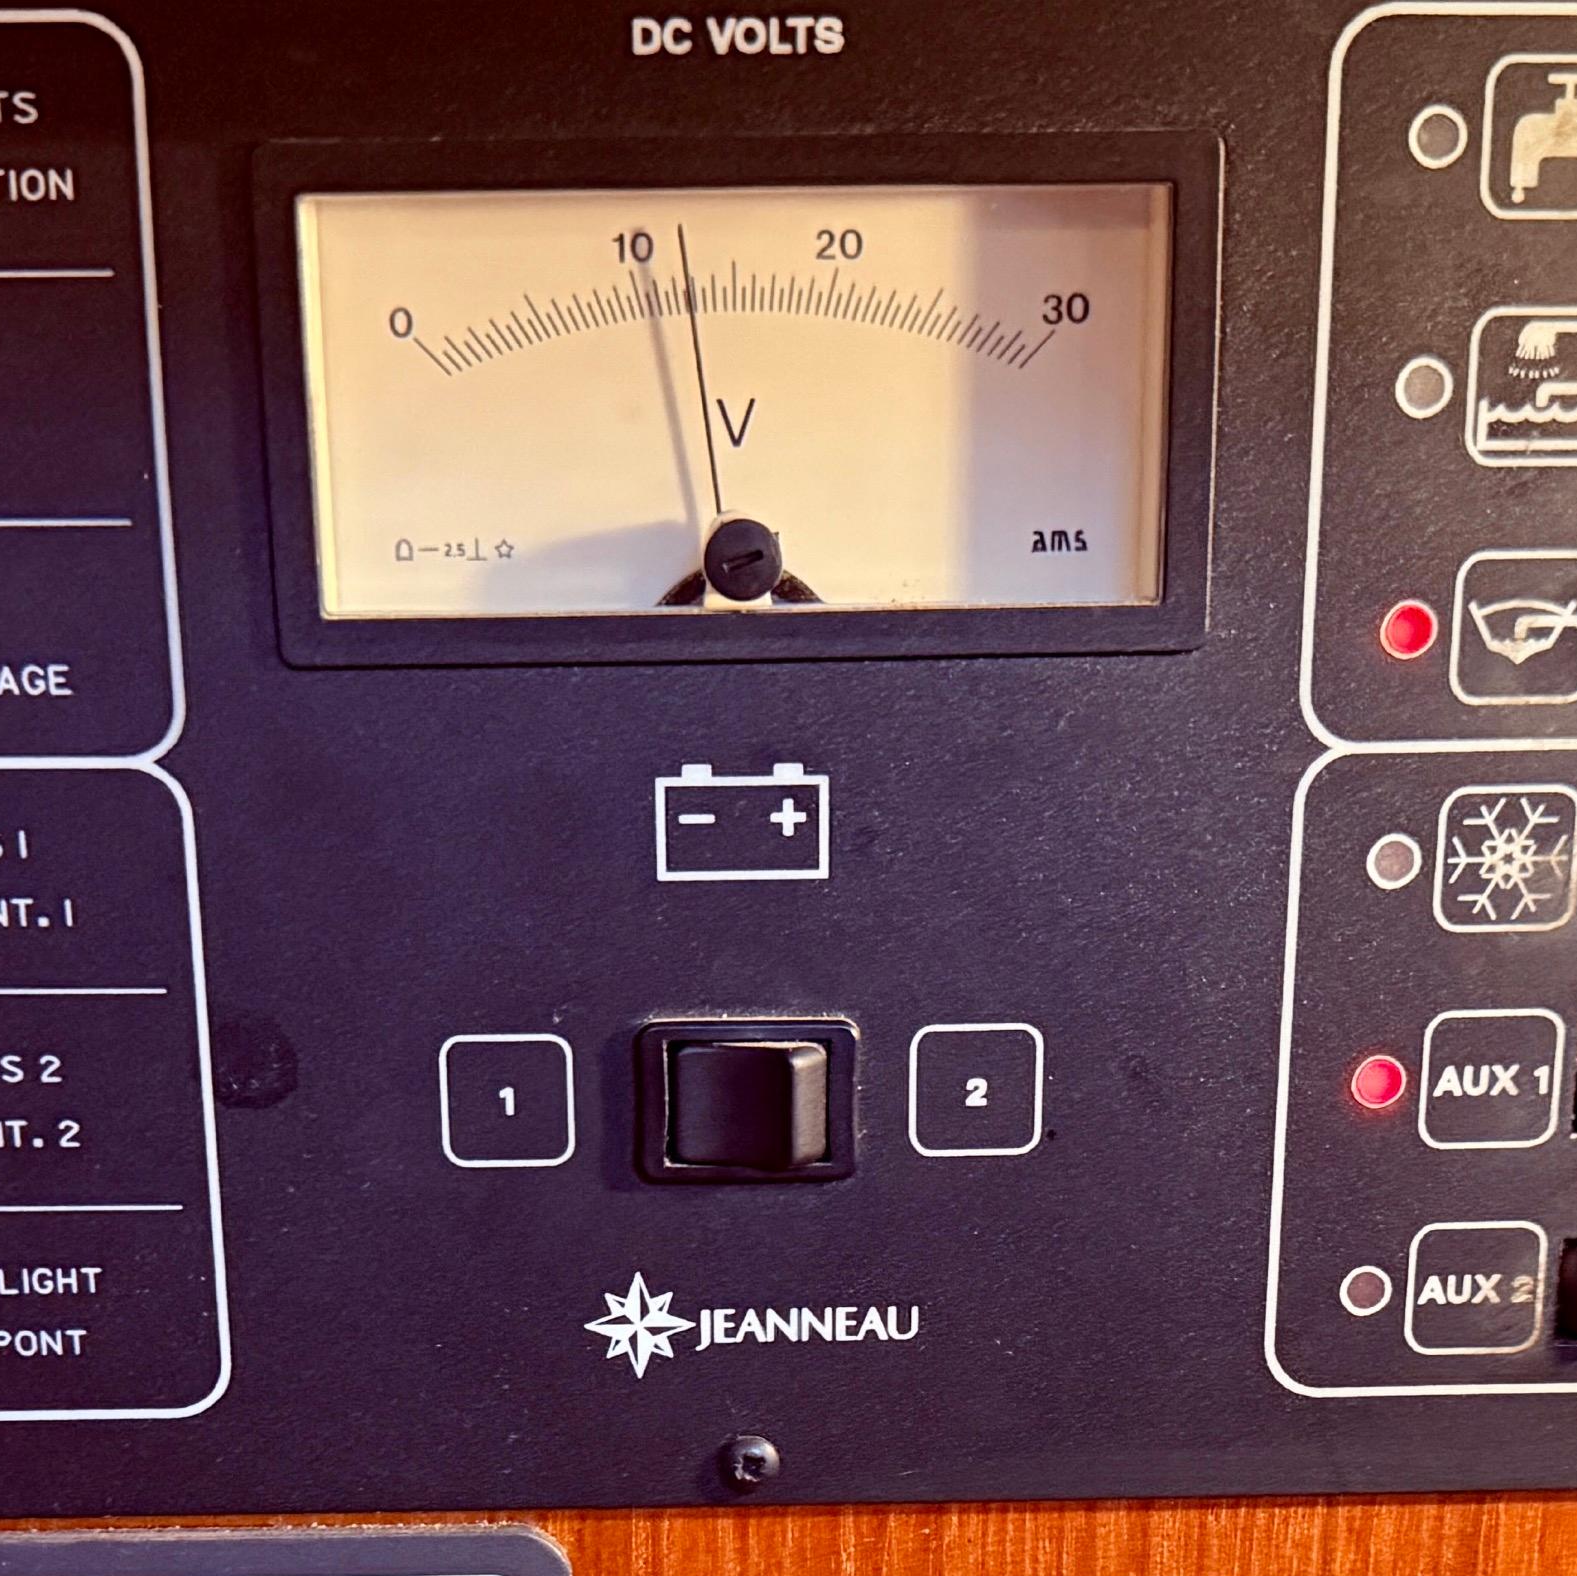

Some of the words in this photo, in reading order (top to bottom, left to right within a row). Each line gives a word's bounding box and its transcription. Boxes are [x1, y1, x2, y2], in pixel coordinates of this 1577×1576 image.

[632, 17, 693, 56] DC
[706, 16, 845, 55] VOLTS
[613, 230, 654, 264] 10
[816, 228, 863, 260] 20
[388, 307, 413, 338] 0
[1042, 292, 1090, 325] 30
[716, 397, 756, 447] V
[1031, 529, 1088, 553] ams
[39, 1054, 62, 1083] 2
[1432, 1064, 1520, 1098] AUX
[1533, 1065, 1550, 1095] 1
[498, 1086, 515, 1116] 1
[965, 1077, 988, 1107] 2
[58, 1119, 81, 1148] 2
[1416, 1273, 1502, 1305] AUX
[1510, 1275, 1534, 1303] 2
[695, 1305, 919, 1352] JEANNEAU
